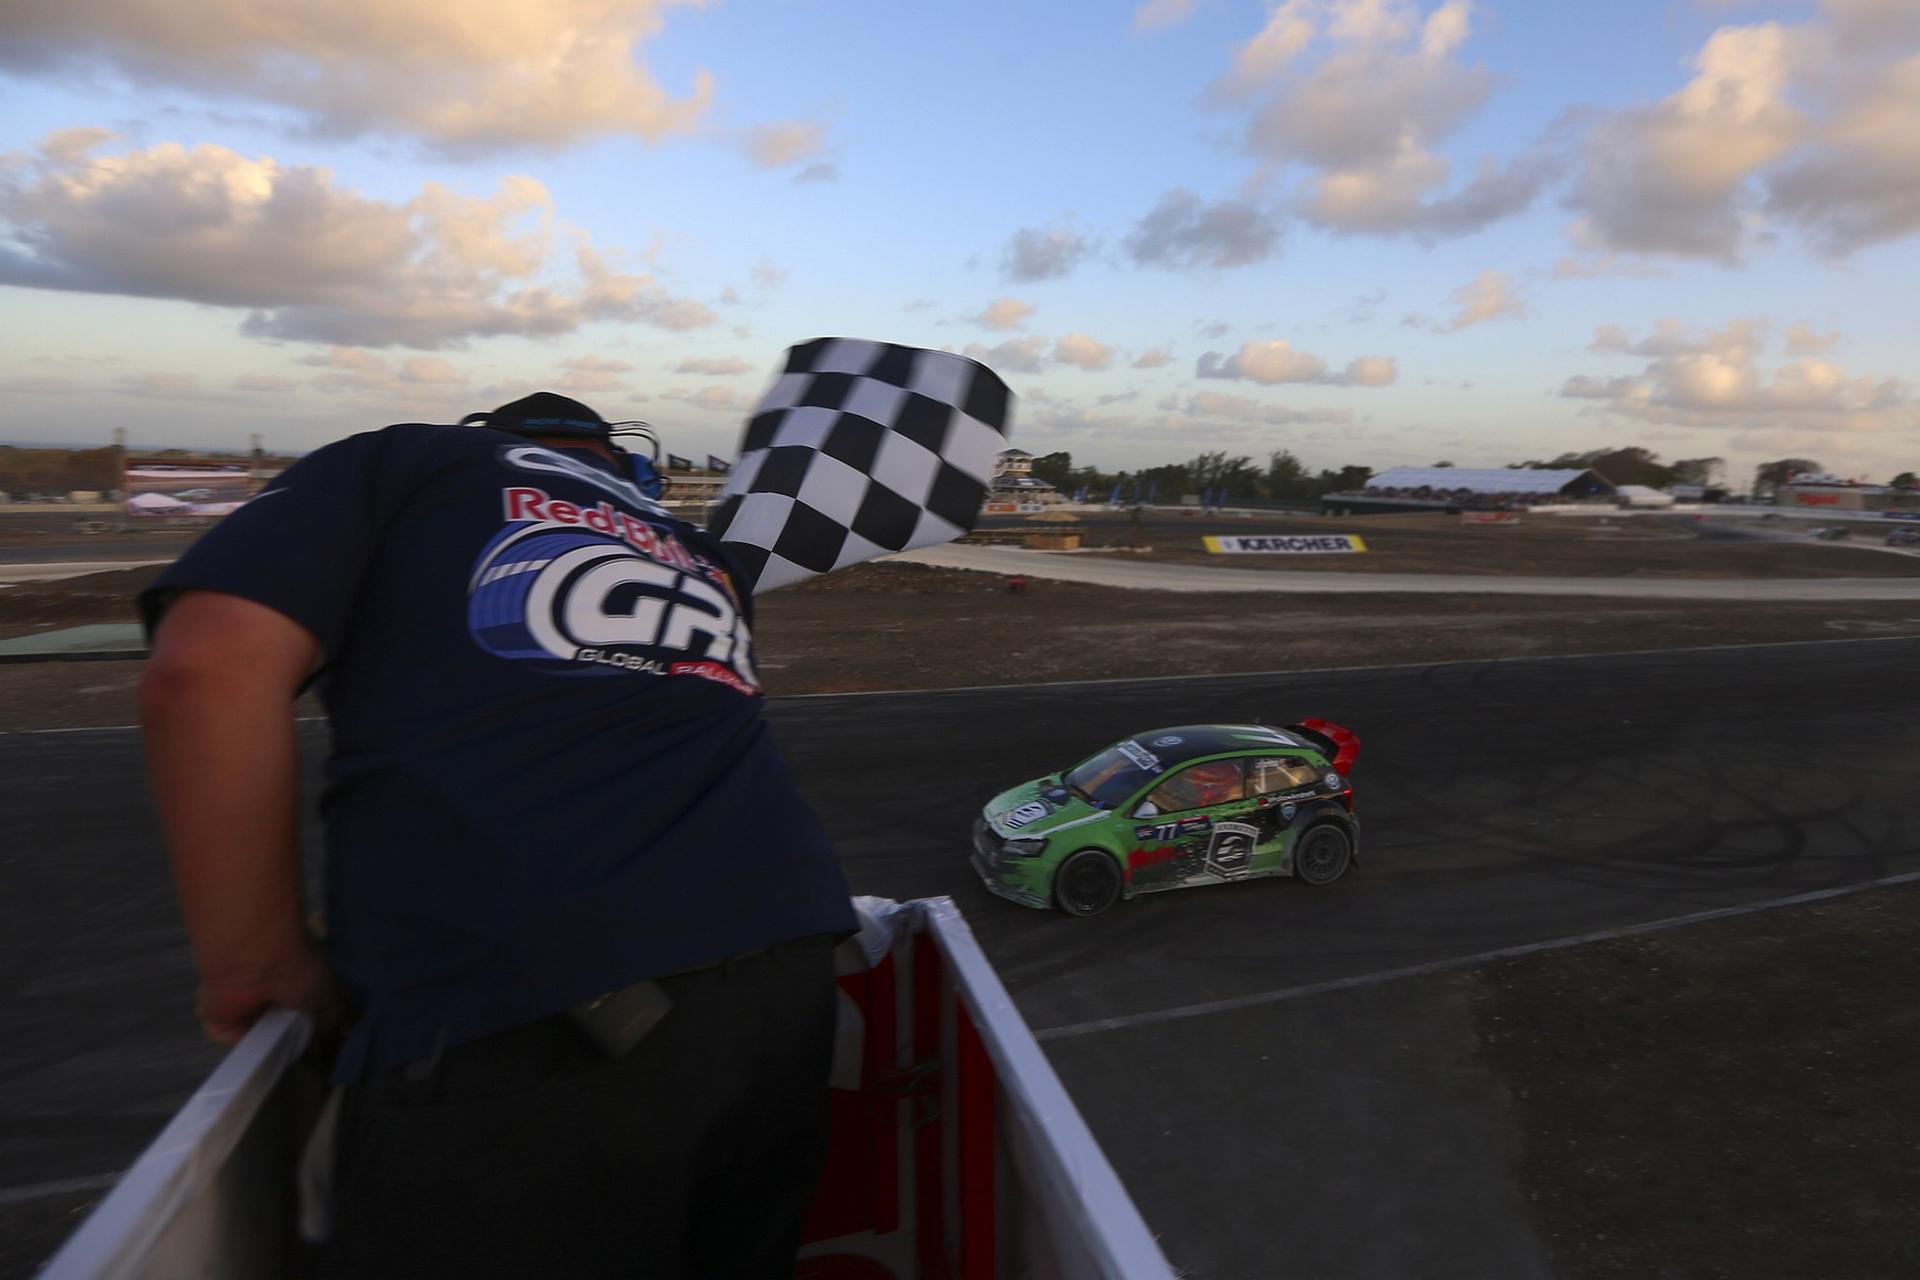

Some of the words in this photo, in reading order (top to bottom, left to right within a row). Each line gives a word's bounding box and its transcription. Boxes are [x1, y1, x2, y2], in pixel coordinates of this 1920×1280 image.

[502, 487, 620, 536] Red
[577, 648, 668, 676] GLOBAL
[1155, 823, 1178, 841] 77
